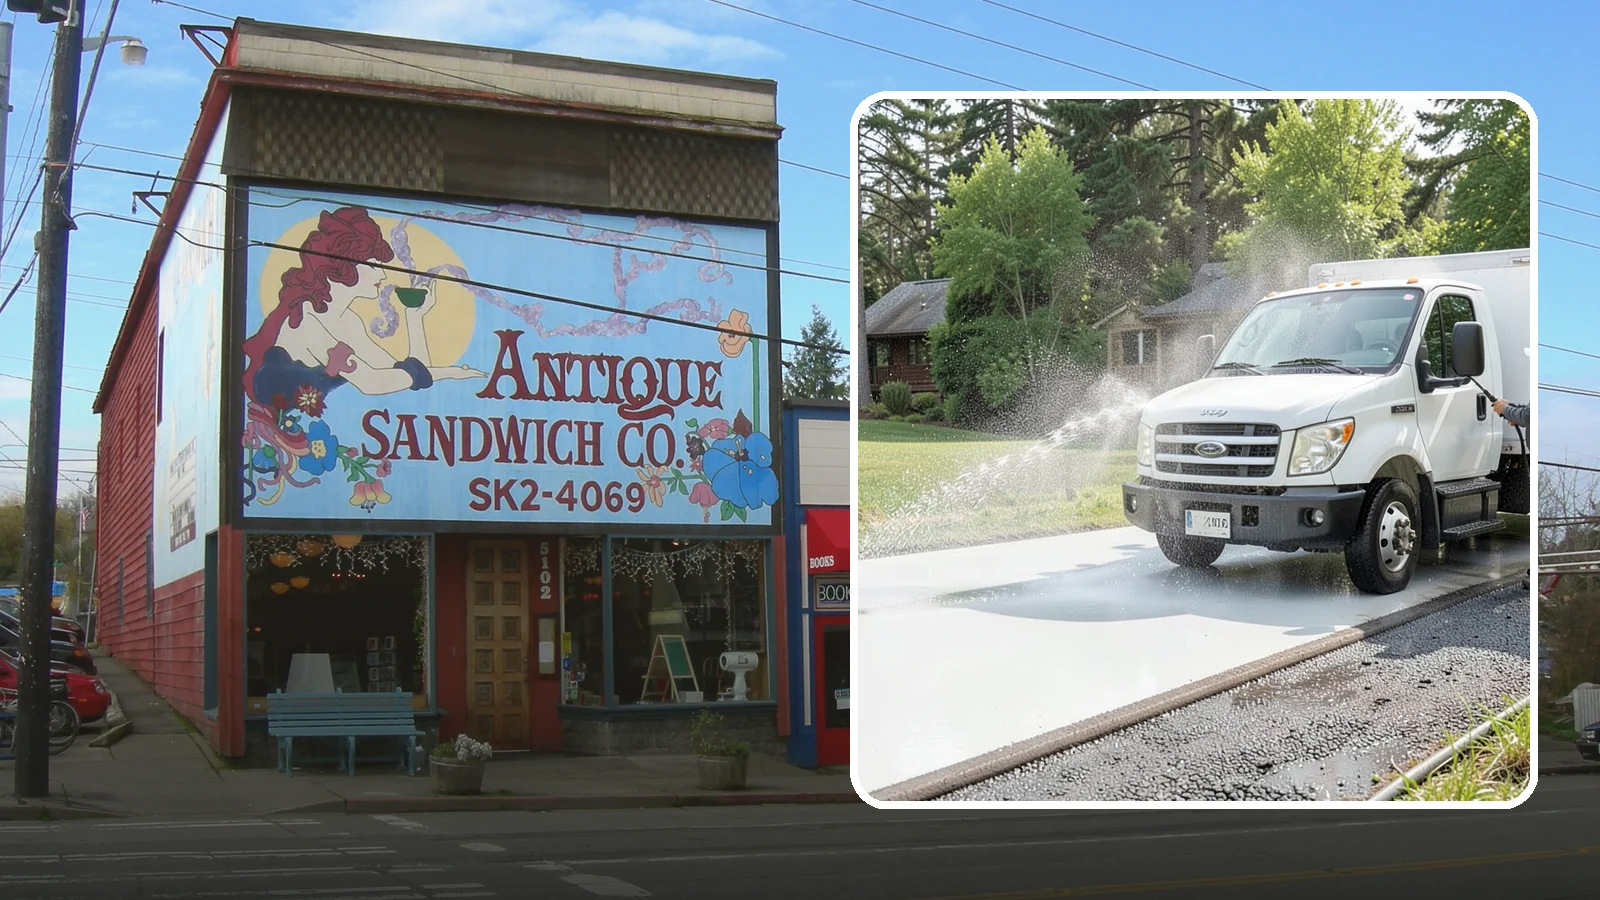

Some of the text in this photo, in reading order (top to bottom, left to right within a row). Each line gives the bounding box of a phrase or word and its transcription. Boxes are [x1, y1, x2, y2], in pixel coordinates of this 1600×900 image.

[476, 330, 723, 421] ANTIQUE
[361, 409, 685, 468] SANDWICH CO.
[469, 477, 645, 513] SK2-4069
[540, 541, 552, 600] 5102
[809, 555, 835, 569] BOOKS
